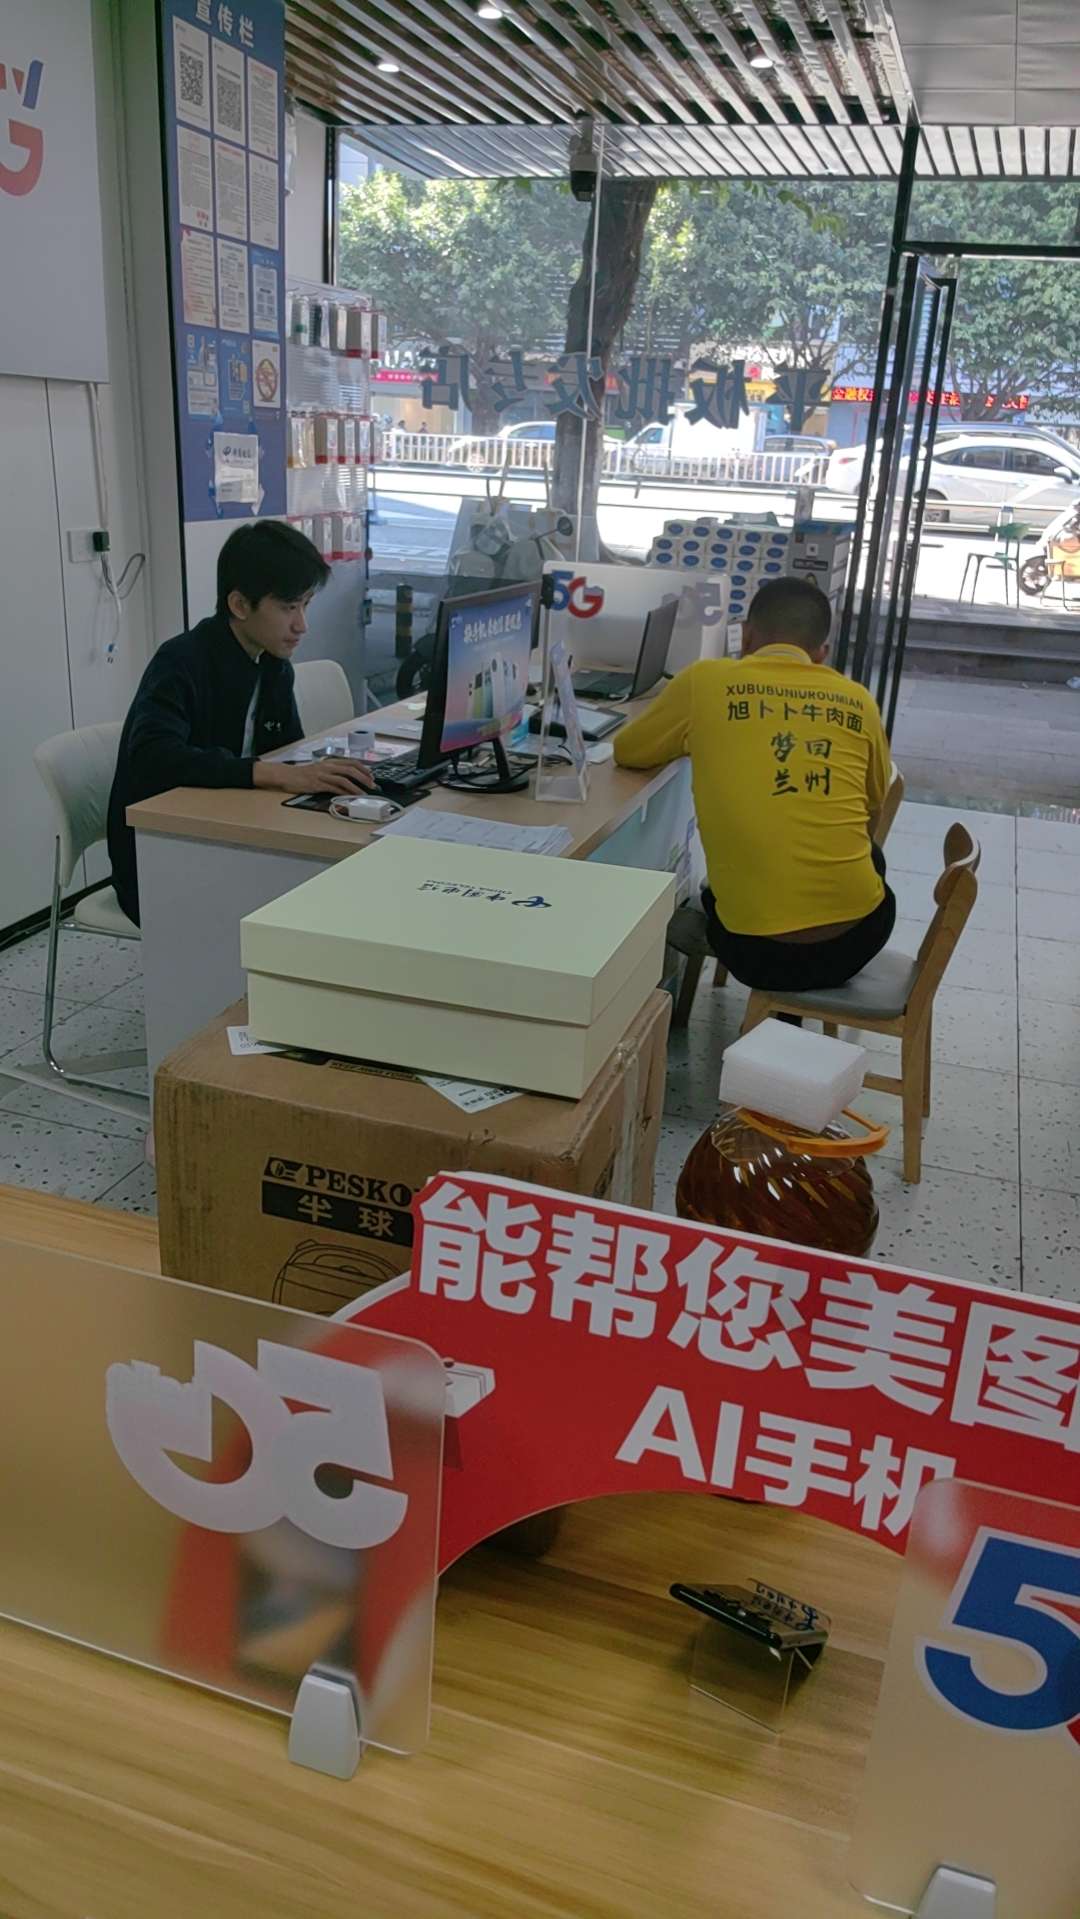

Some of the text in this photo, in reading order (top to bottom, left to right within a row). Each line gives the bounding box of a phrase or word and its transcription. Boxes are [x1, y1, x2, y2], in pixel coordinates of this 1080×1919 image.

[552, 570, 604, 619] 5G
[727, 700, 864, 733] 旭卜卜牛肉面
[771, 767, 831, 796] 兰州
[304, 1164, 420, 1208] PESKO
[297, 1193, 395, 1238] 半球
[419, 1180, 1080, 1453] 能帮您美图
